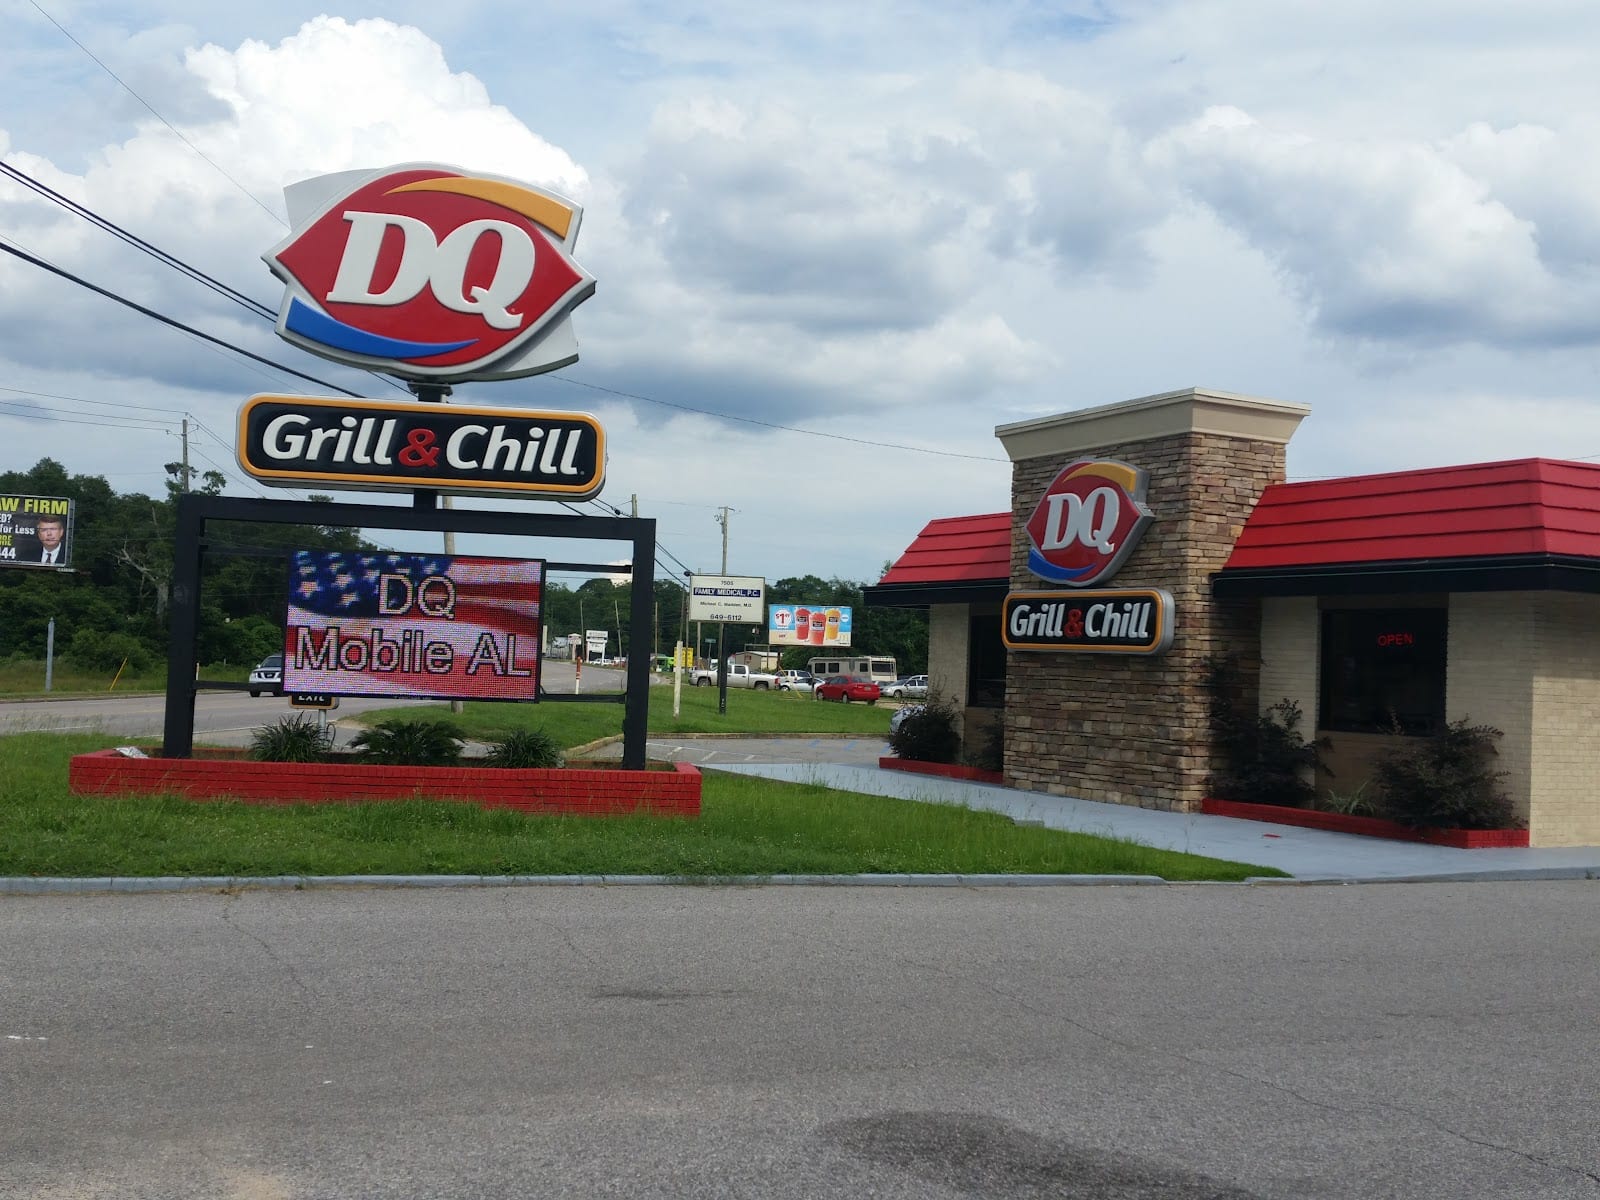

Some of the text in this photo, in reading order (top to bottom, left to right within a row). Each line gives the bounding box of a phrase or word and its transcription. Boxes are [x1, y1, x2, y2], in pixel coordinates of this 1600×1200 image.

[326, 210, 535, 330] DQ
[262, 414, 583, 476] Grill & Chill
[15, 524, 35, 535] Less
[24, 498, 68, 515] FIRM
[1041, 486, 1120, 555] DQ
[379, 573, 456, 620] DQ
[1010, 602, 1151, 638] Grill & Chill
[294, 625, 532, 676] Mobile AL
[1377, 632, 1413, 647] OPEN
